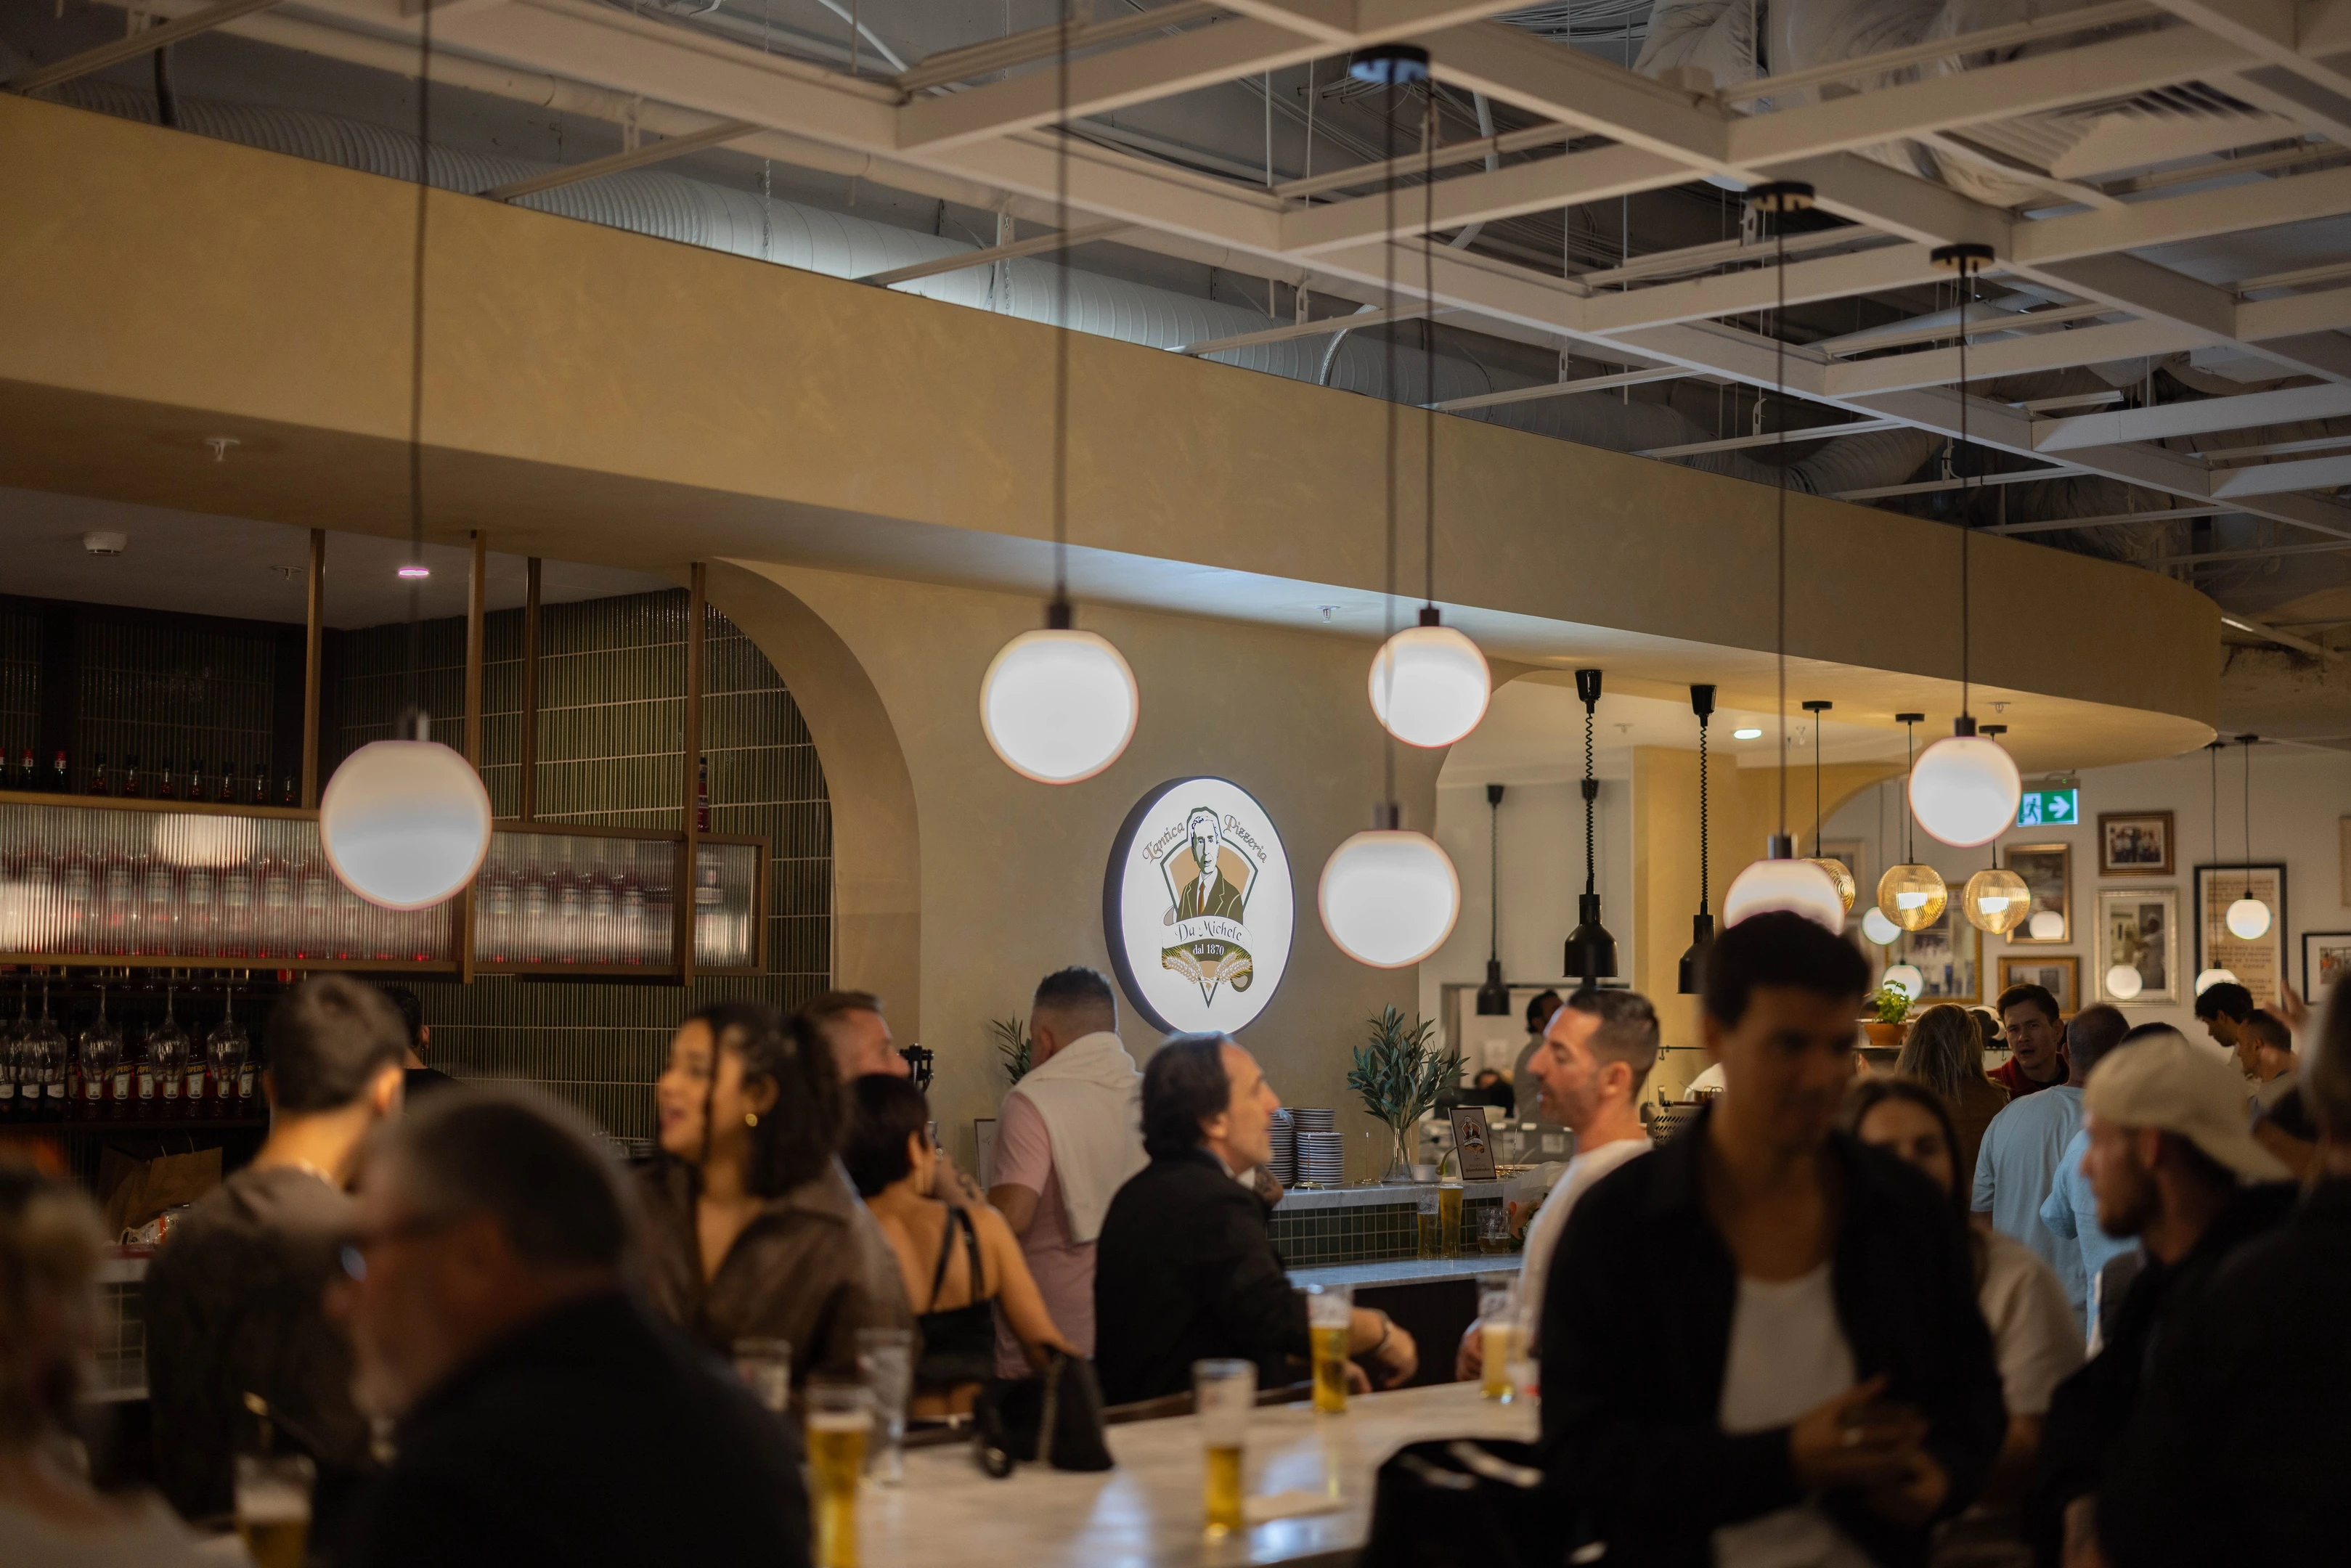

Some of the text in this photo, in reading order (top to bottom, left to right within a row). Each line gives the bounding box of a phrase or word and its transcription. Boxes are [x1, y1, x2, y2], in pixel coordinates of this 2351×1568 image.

[1223, 814, 1268, 863] Pizzeria
[1175, 920, 1242, 942] Da Michele
[1193, 944, 1225, 955] dal 1870
